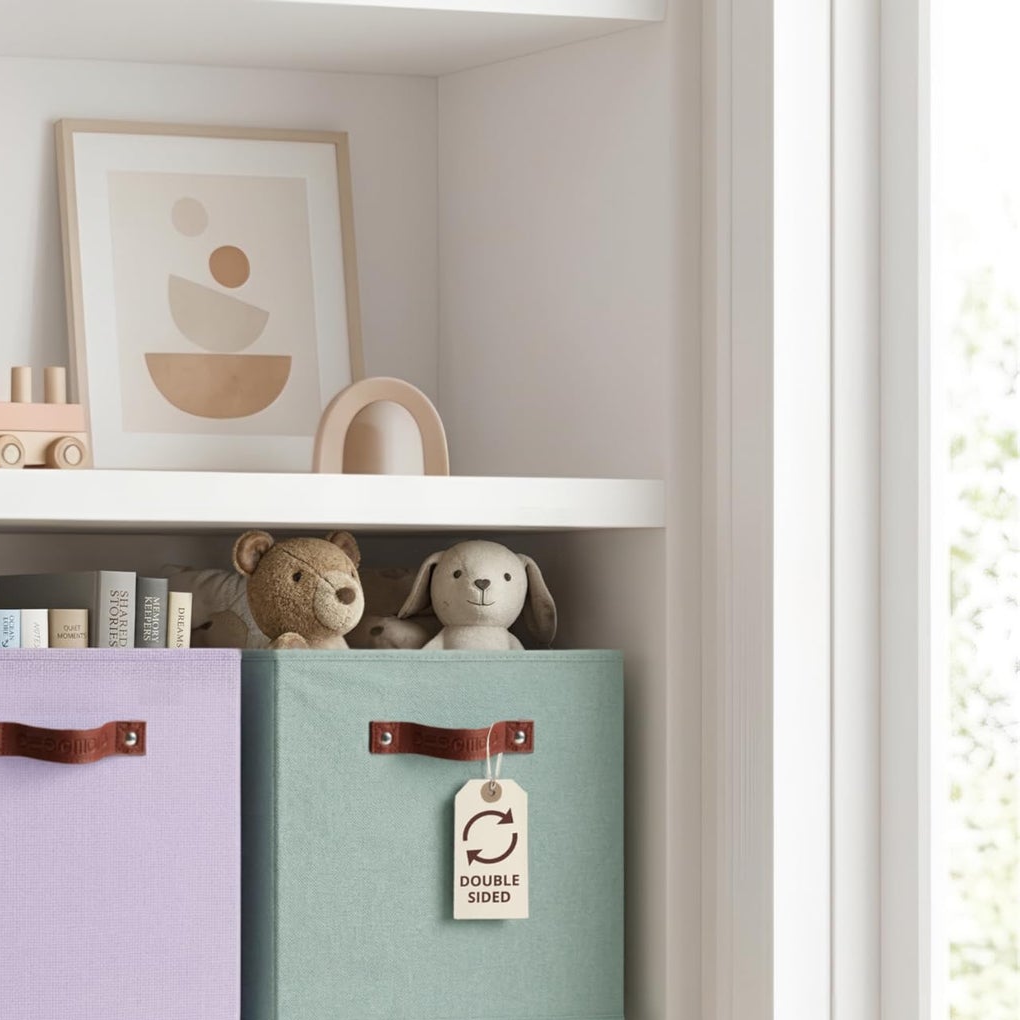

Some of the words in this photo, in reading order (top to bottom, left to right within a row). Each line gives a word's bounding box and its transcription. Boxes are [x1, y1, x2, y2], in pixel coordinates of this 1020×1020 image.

[63, 624, 82, 632] QUIET
[108, 589, 119, 648] STORIES
[119, 590, 129, 648] SHARED
[143, 596, 152, 641] KEEPERS
[152, 597, 161, 643] MEMORY
[176, 607, 185, 648] DREAMS
[460, 874, 520, 887] DOUBLE
[467, 891, 511, 903] SIDED
